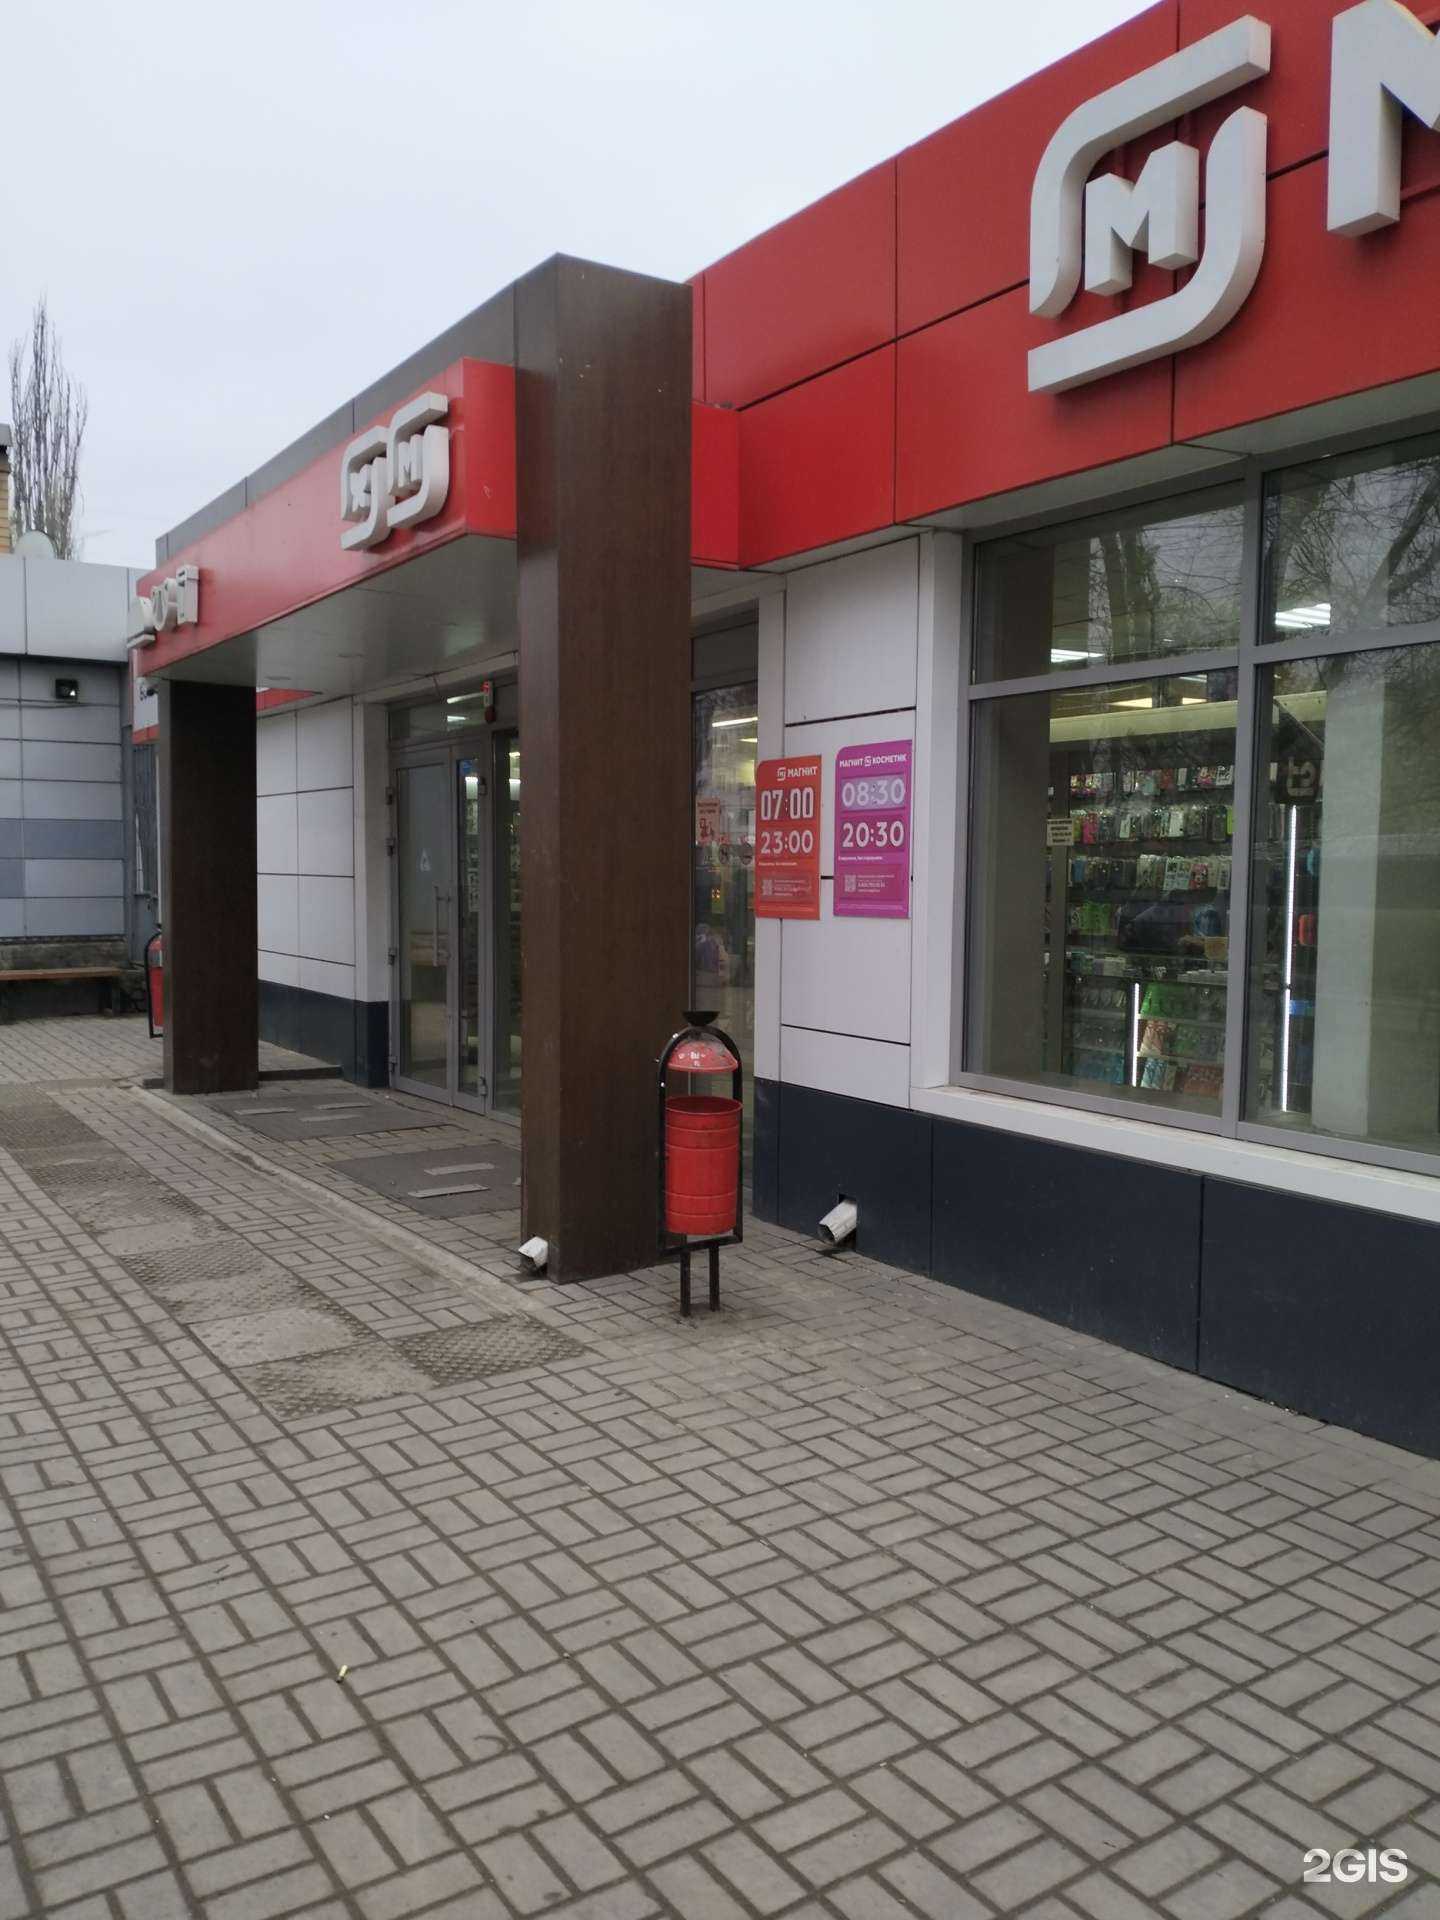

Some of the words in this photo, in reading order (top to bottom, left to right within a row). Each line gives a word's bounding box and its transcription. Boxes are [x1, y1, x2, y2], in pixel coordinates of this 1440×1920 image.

[787, 766, 818, 778] МАГНИТ
[840, 757, 864, 768] МАГНИТ
[872, 753, 907, 766] КОСМЕТИК
[761, 787, 814, 821] 07:00
[841, 779, 906, 807] 08:30
[760, 829, 814, 854] 23:00
[841, 821, 905, 848] 20:30
